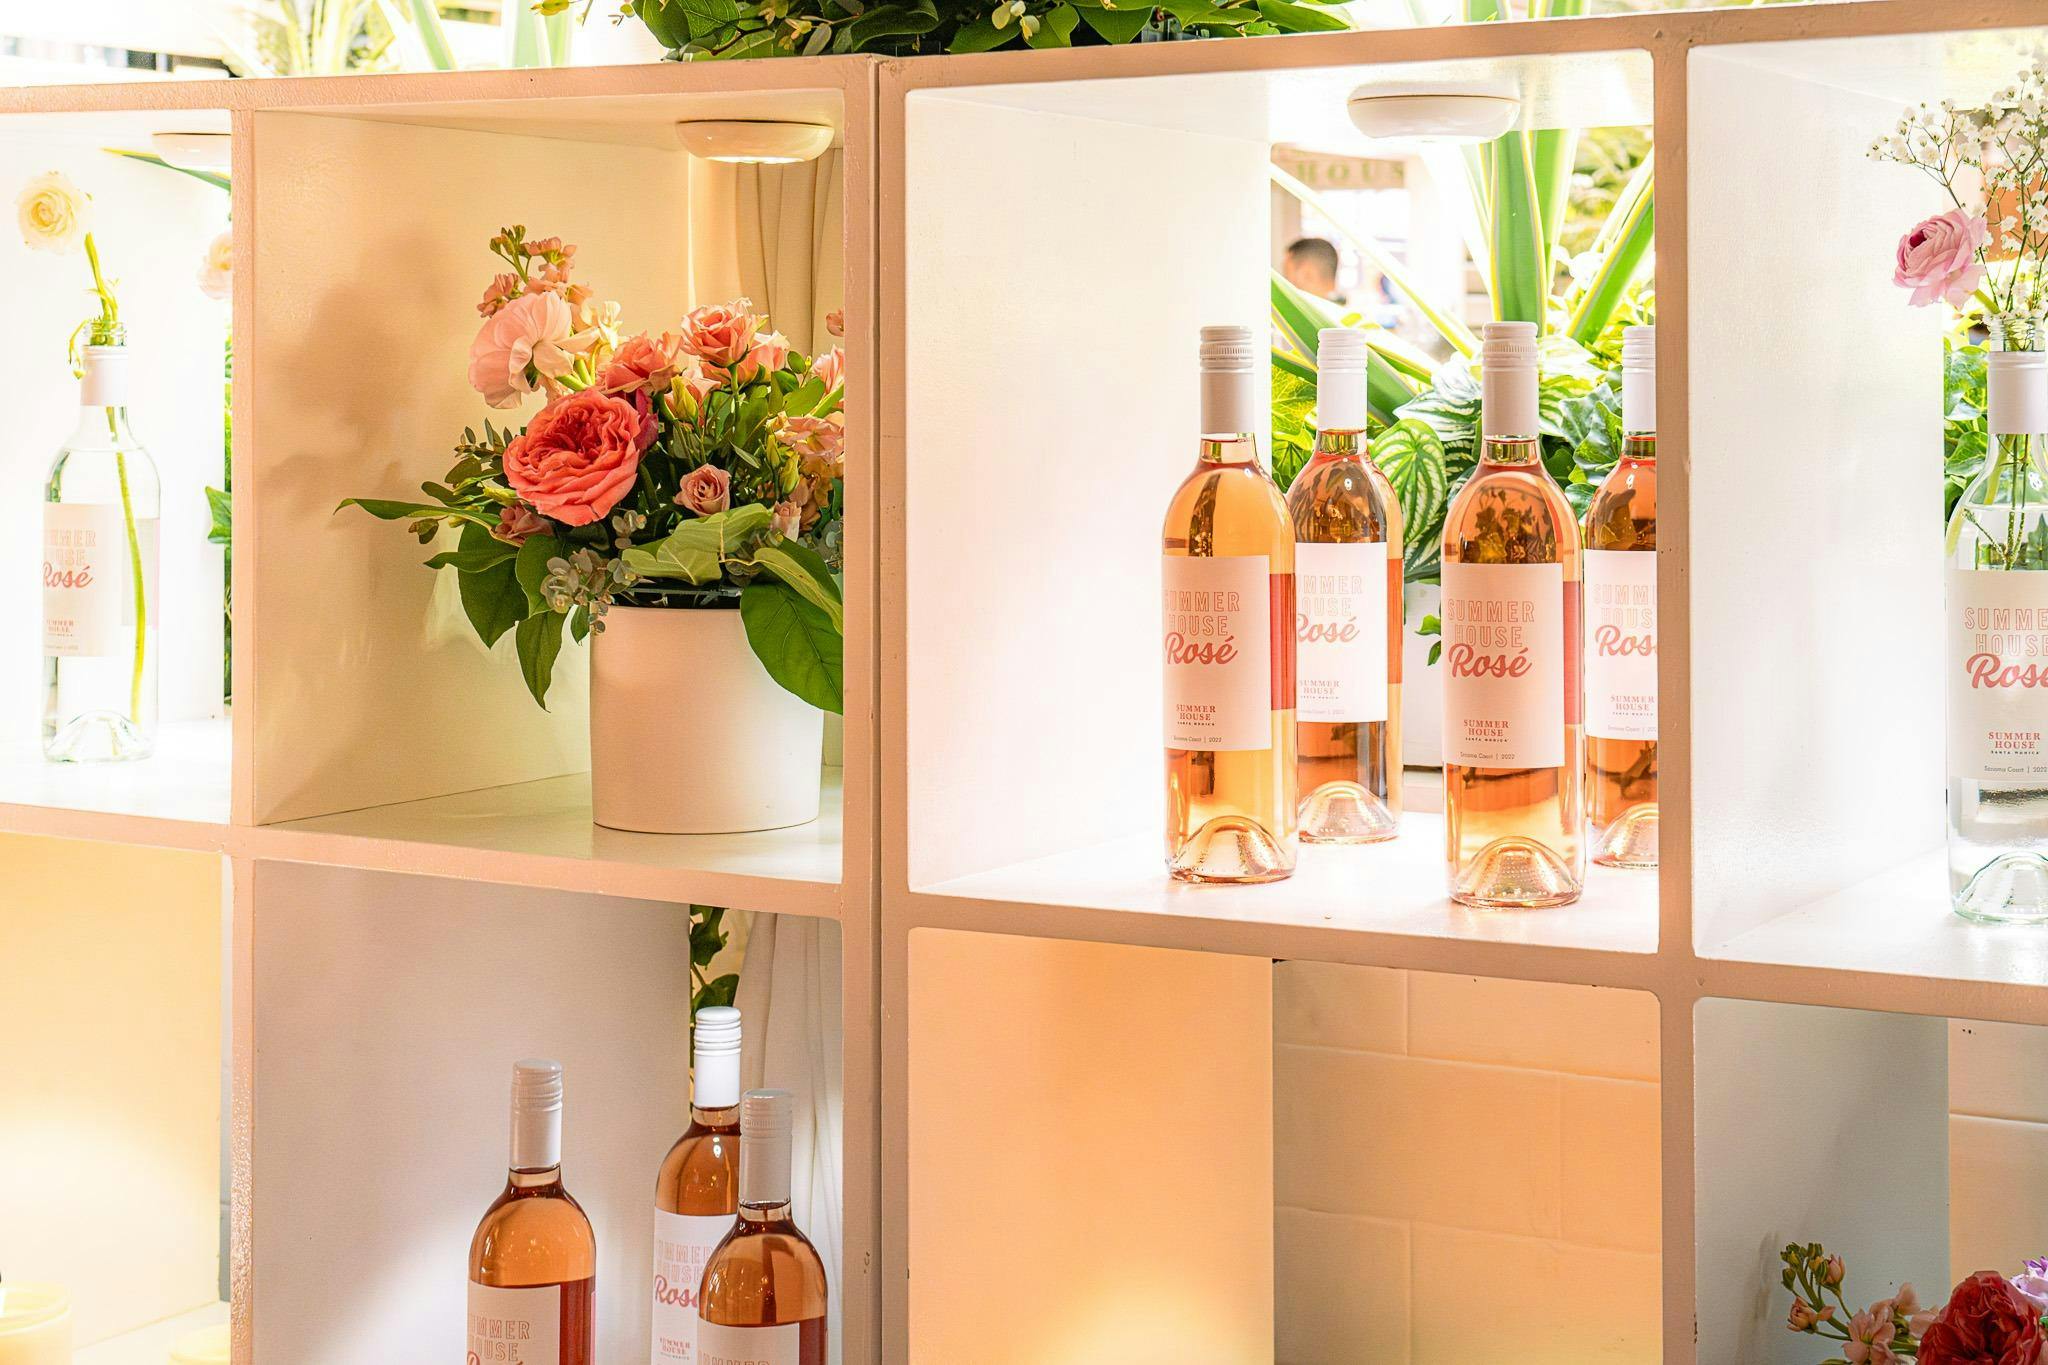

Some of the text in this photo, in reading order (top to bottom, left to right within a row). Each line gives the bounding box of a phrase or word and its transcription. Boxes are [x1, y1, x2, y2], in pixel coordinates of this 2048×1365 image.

[1296, 159, 1405, 183] HOUS
[1297, 575, 1364, 595] MMER
[1165, 591, 1240, 612] UMMER
[1301, 597, 1352, 617] OUSE
[1448, 599, 1535, 623] SUMMER
[1601, 608, 1654, 629] HOUS
[1964, 606, 2048, 631] SUMME
[1454, 625, 1523, 648] HOUSE
[1594, 624, 1657, 657] Ros
[1165, 632, 1239, 665] Rosé
[1448, 643, 1533, 678] Rosé
[1966, 652, 2048, 689] Ros
[1176, 704, 1217, 713] SUMMER
[1180, 713, 1212, 721] HOUSE
[1463, 719, 1510, 729] SUMMER
[1468, 728, 1504, 737] HOUSE
[1988, 731, 2041, 741] SUMMER
[1994, 740, 2036, 749] HOUSE
[475, 1337, 520, 1362] OUSE
